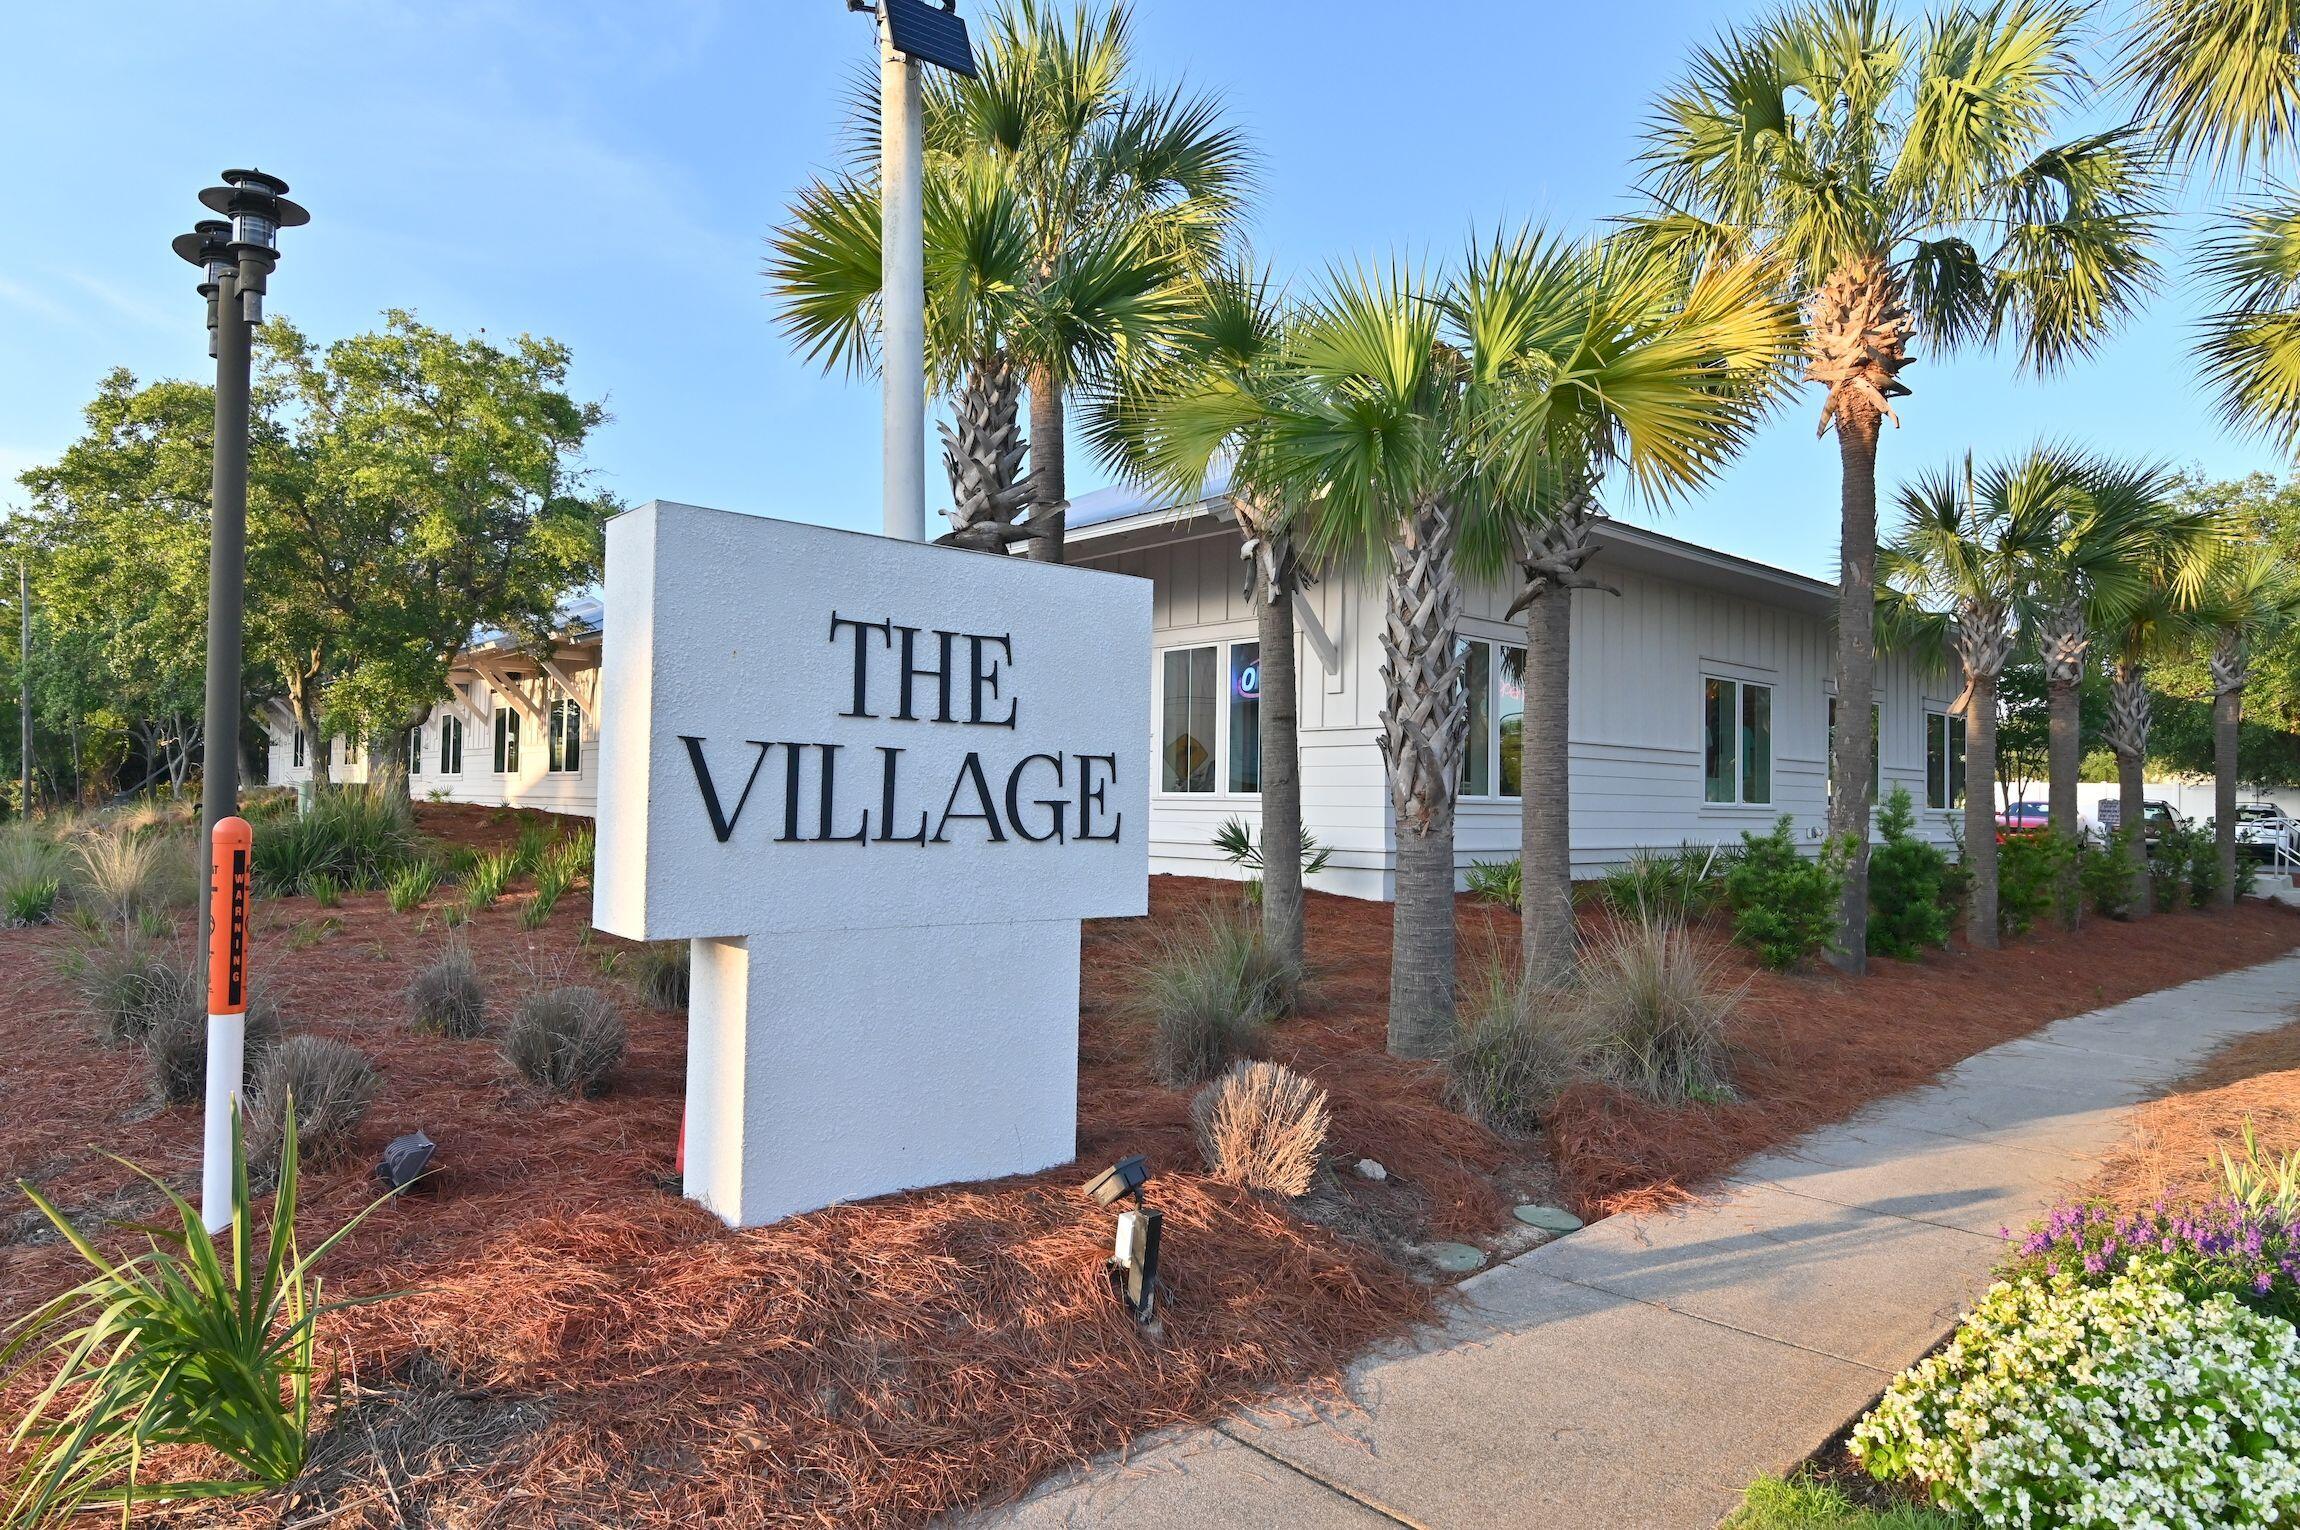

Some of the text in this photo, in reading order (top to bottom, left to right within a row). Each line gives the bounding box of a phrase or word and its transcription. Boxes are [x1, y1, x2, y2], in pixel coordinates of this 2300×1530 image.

[829, 610, 1018, 730] THE
[677, 735, 1121, 847] VILLAGE
[232, 873, 245, 982] WARNING
